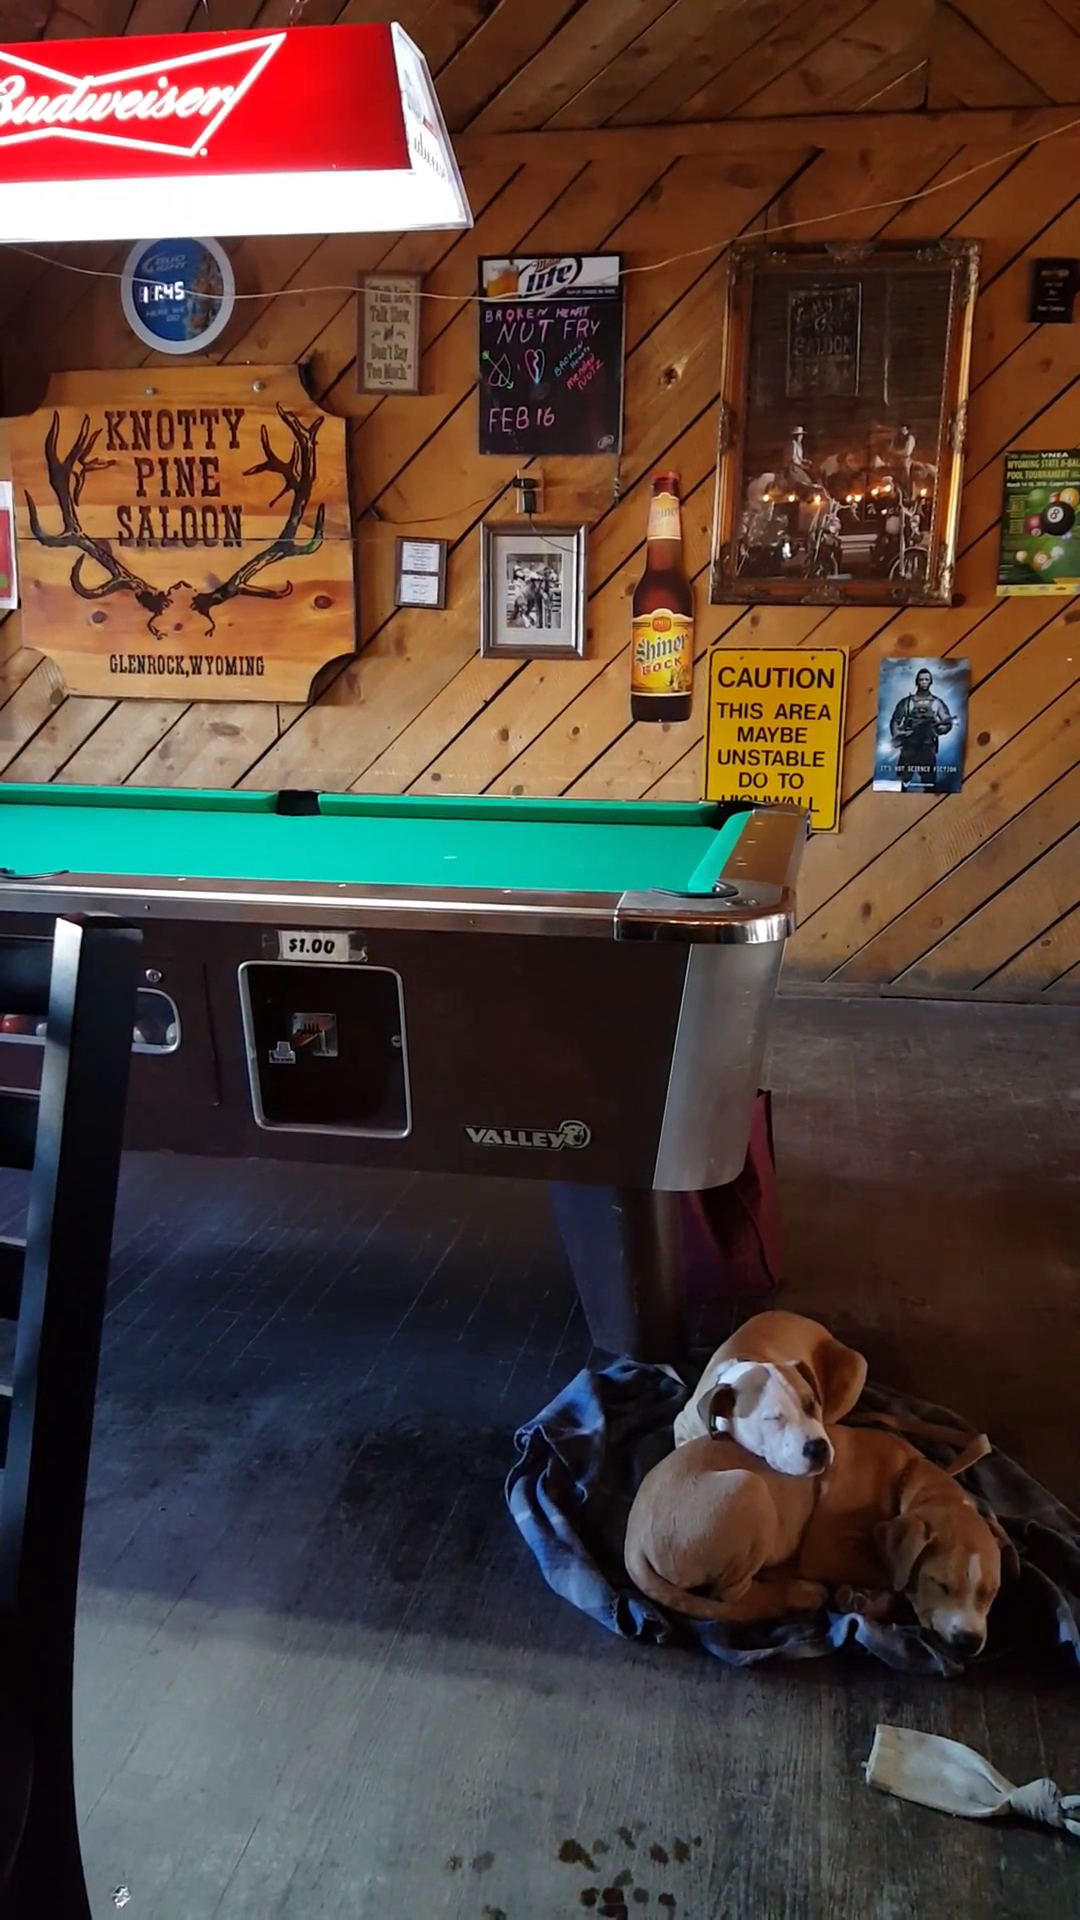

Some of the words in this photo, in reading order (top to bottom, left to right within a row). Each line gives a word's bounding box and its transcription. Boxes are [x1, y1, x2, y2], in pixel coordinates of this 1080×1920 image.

[0, 74, 237, 126] Budweiser
[143, 281, 185, 304] 11:45
[485, 307, 548, 323] BROKEN
[556, 306, 590, 318] HEART
[496, 319, 554, 344] NUT
[563, 318, 600, 340] FRY
[104, 407, 245, 451] KNOTTY
[488, 406, 530, 433] FEB
[537, 407, 555, 427] 16
[134, 456, 221, 498] PINE
[1006, 470, 1024, 480] POOL
[116, 504, 243, 548] SALOON
[636, 633, 688, 662] Shiner
[642, 656, 682, 676] BOCK
[718, 666, 835, 689] CAUTION
[716, 702, 763, 719] THIS
[774, 703, 831, 721] AREA
[737, 726, 808, 743] MAYBE
[717, 749, 826, 768] UNSTABLE
[907, 765, 931, 773] SCIENCE
[738, 772, 768, 789] DO
[778, 772, 804, 790] TO
[289, 938, 335, 955] $1.00
[465, 1127, 566, 1148] VALLEY
